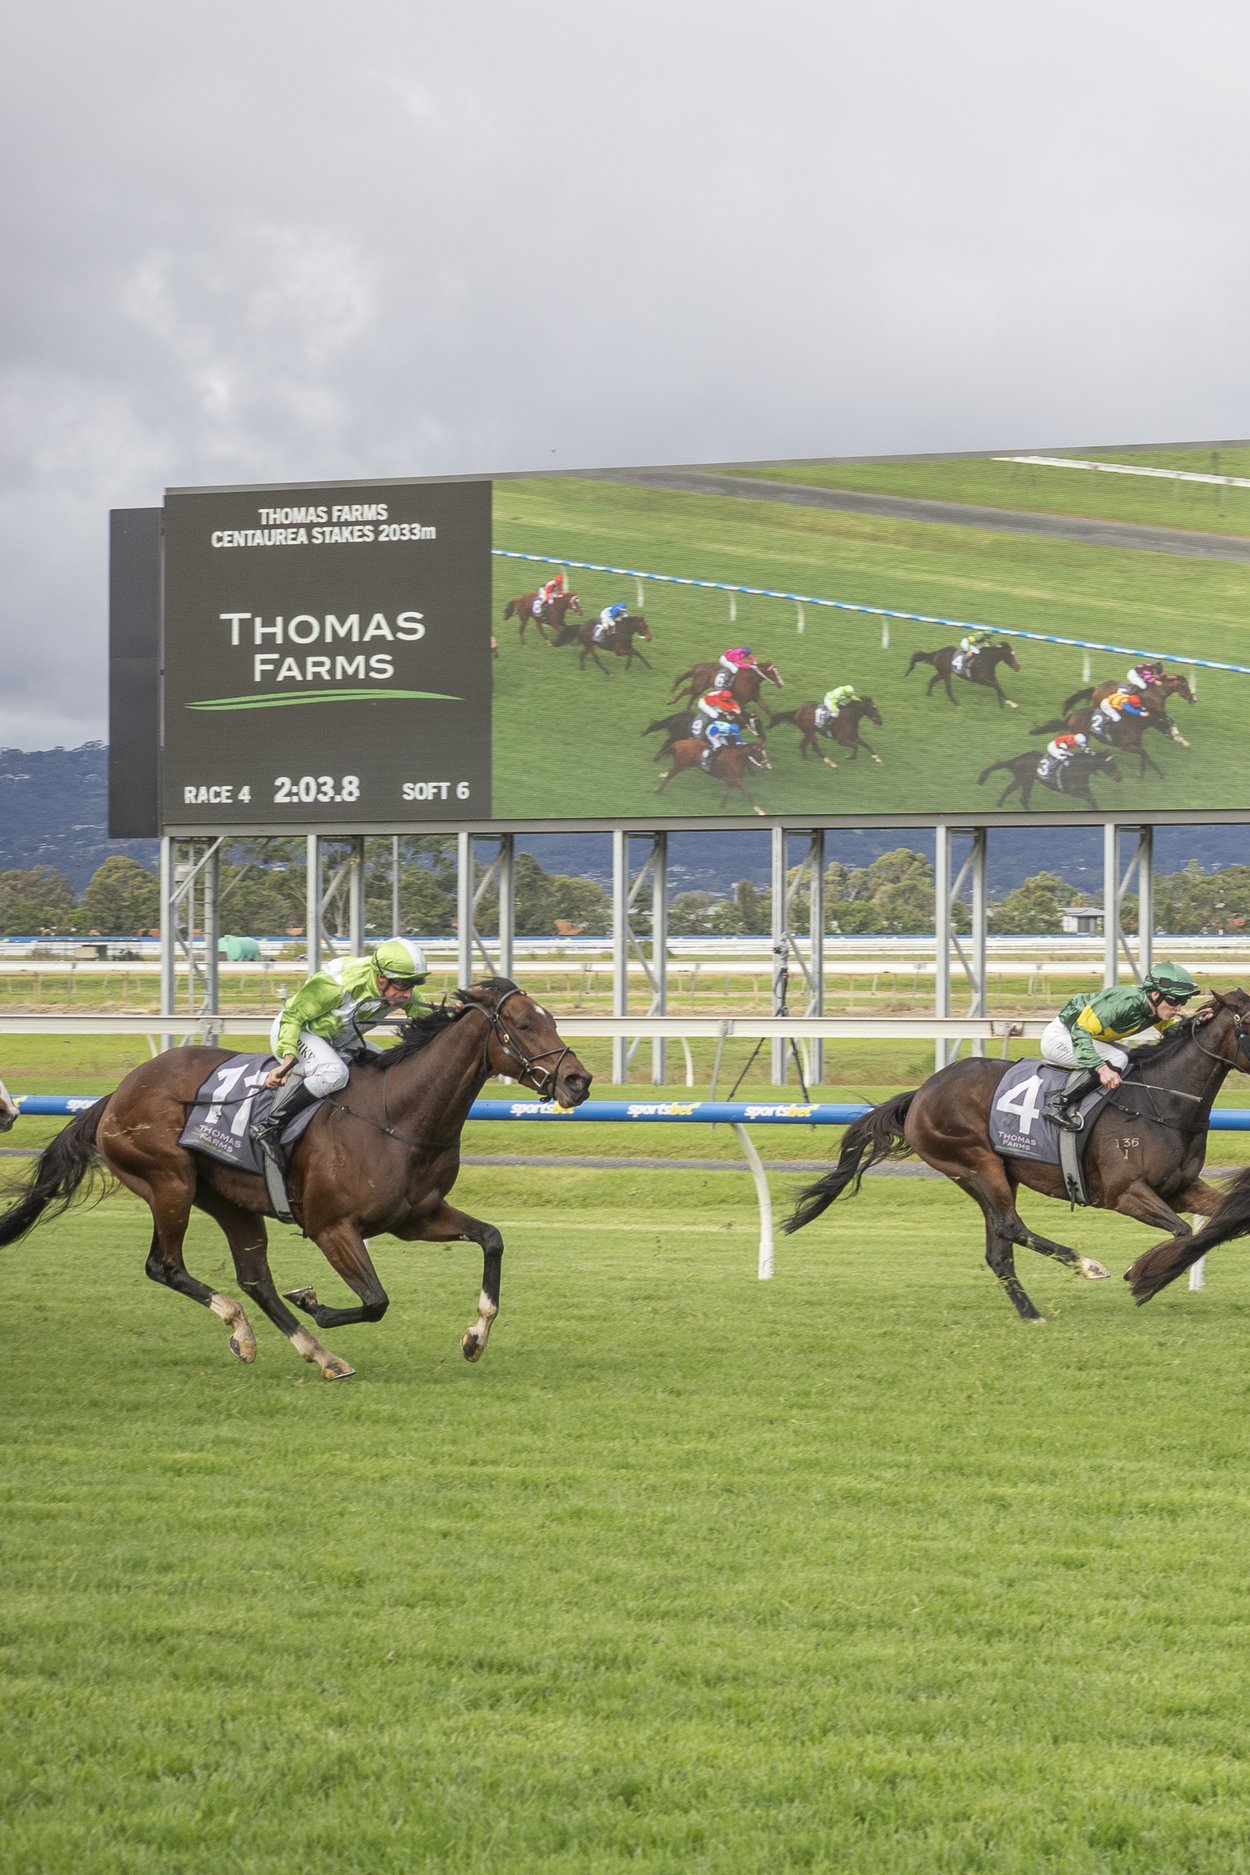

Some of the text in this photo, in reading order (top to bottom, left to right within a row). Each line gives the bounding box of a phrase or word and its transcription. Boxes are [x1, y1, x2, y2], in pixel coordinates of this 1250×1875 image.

[258, 504, 388, 525] THOMAS FARMS
[211, 523, 436, 548] CENTAUREA STAKES 2033m
[219, 611, 426, 645] THOMAS
[253, 653, 395, 682] FARMS
[1037, 758, 1050, 776] 3
[184, 785, 251, 804] RACE 4
[273, 775, 361, 803] 2:03.8
[402, 781, 470, 801] SOFT 6
[205, 1064, 269, 1137] 11
[627, 1102, 699, 1117] sportsbet
[996, 1074, 1043, 1135] 4
[744, 1104, 819, 1119] sportsbet
[199, 1124, 242, 1149] THOMAS
[199, 1132, 233, 1153] FARMS
[998, 1131, 1037, 1146] THOMAS
[1002, 1139, 1031, 1151] FARMS
